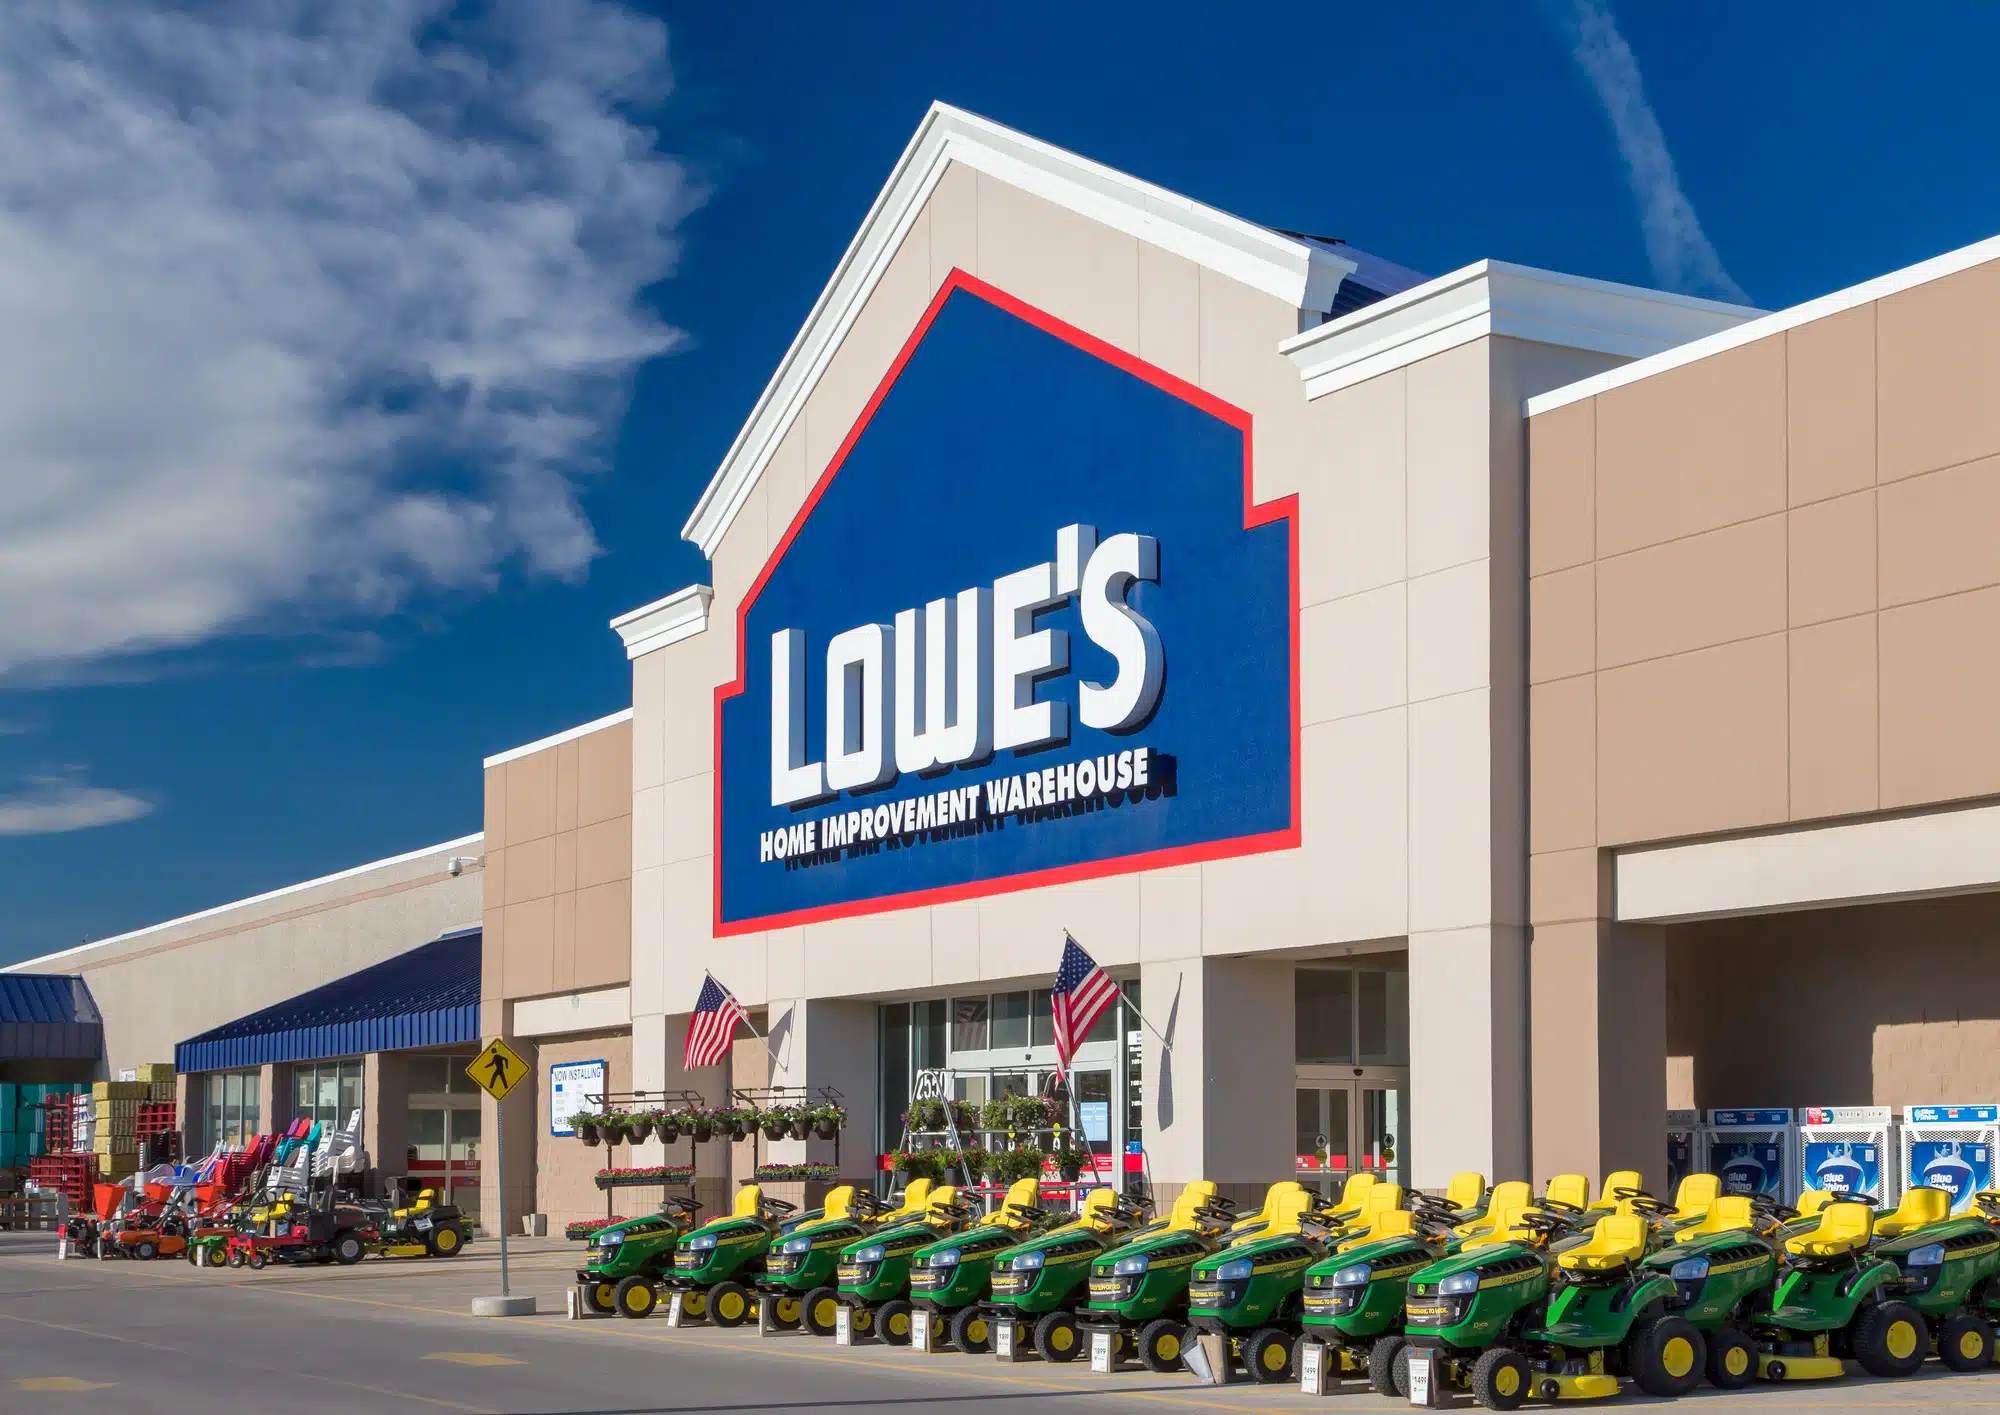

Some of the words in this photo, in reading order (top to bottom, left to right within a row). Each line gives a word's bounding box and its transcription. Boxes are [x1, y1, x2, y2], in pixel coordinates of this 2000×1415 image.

[771, 523, 1164, 808] LOWE'S
[760, 820, 816, 863] HOME
[821, 784, 981, 850] IMPROVEMENT
[986, 747, 1149, 815] WAREHOUSE
[554, 1070, 567, 1082] NOW
[569, 1066, 601, 1080] INSTALLING
[1823, 1172, 1845, 1182] Blue
[1930, 1173, 1953, 1183] Blue
[1500, 1274, 1518, 1285] JOHN
[1518, 1269, 1537, 1281] DEERE
